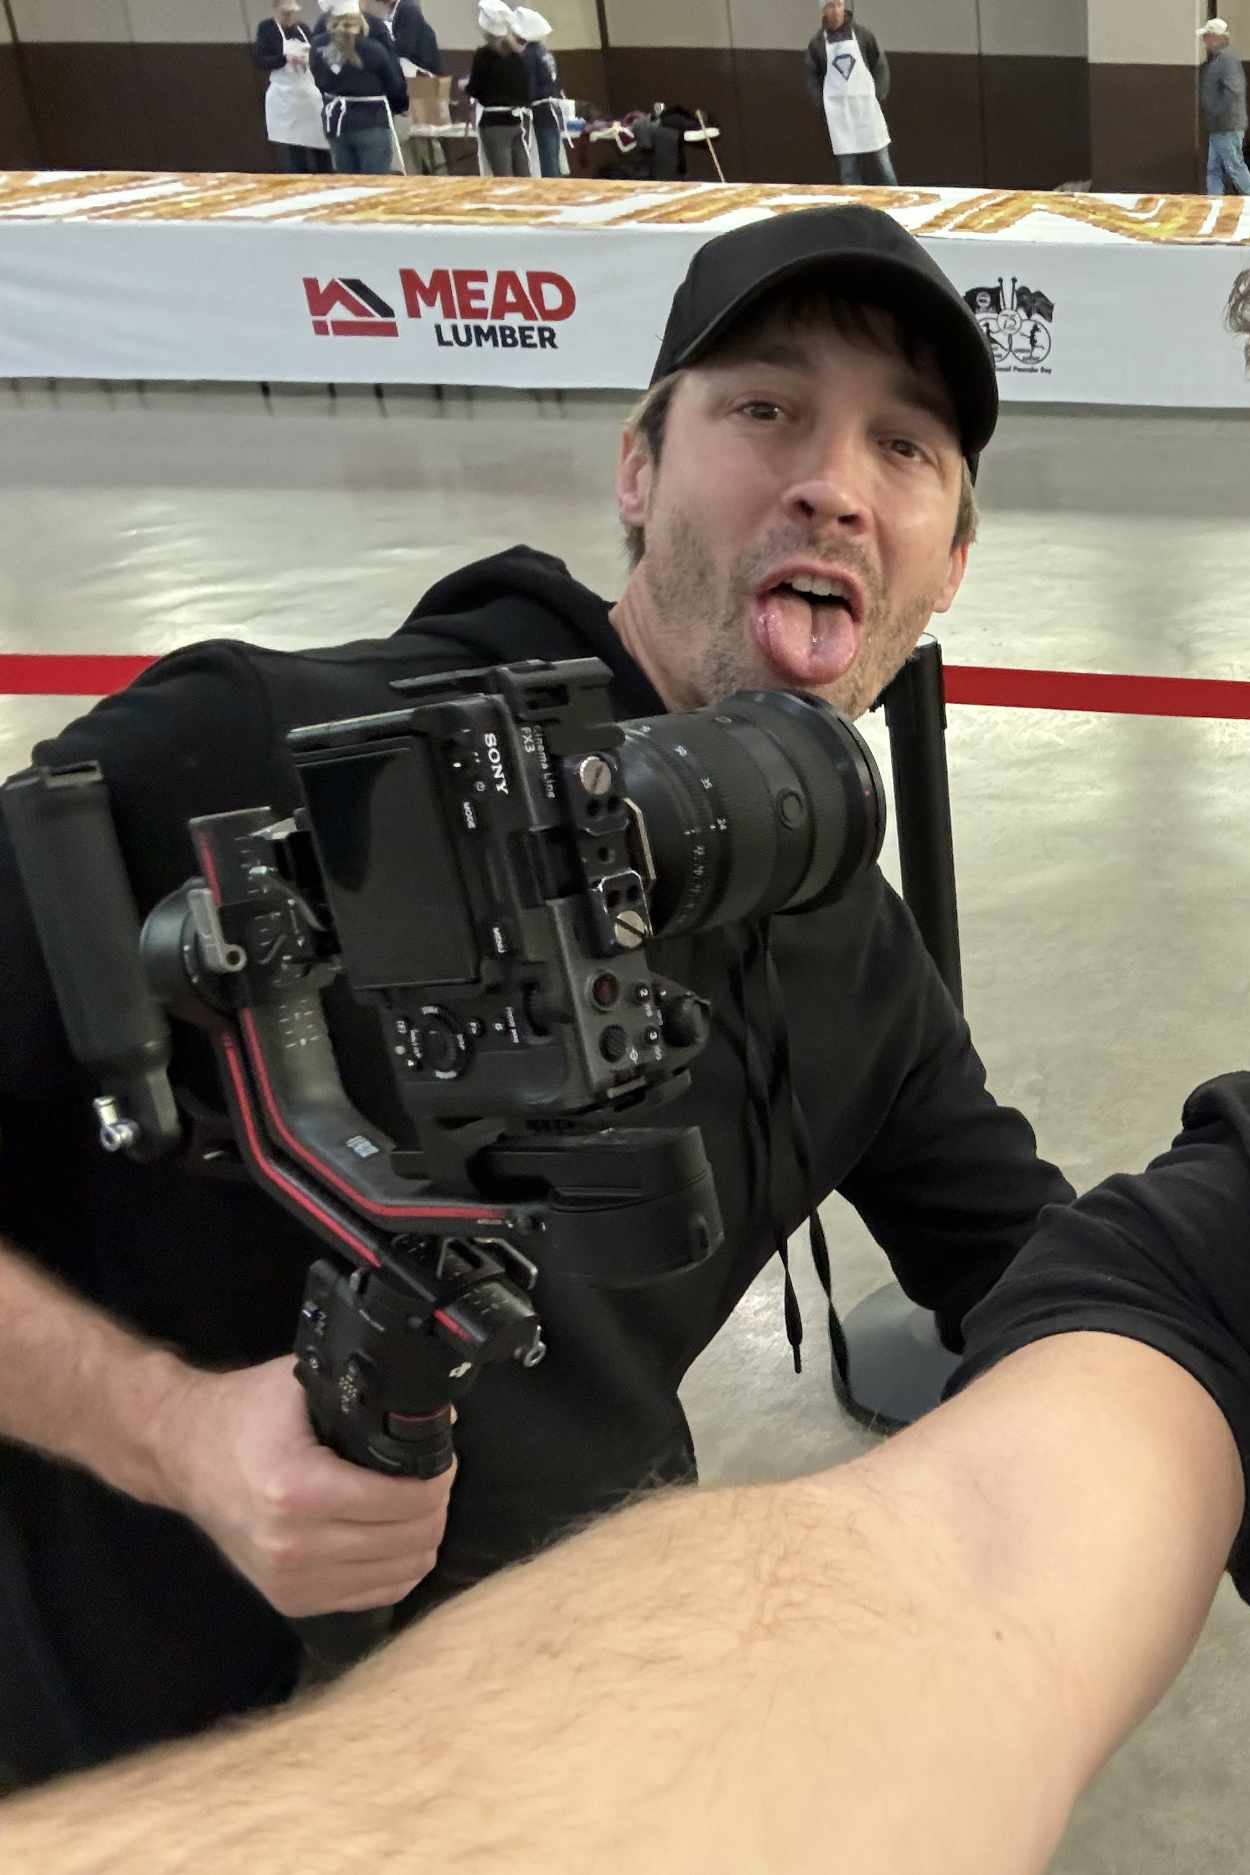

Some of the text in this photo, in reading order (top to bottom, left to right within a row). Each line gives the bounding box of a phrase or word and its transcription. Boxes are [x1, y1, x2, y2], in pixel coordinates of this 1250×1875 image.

[399, 268, 576, 321] MEAD
[434, 324, 558, 349] LUMBER
[520, 726, 535, 753] FX3
[484, 732, 508, 795] SONY
